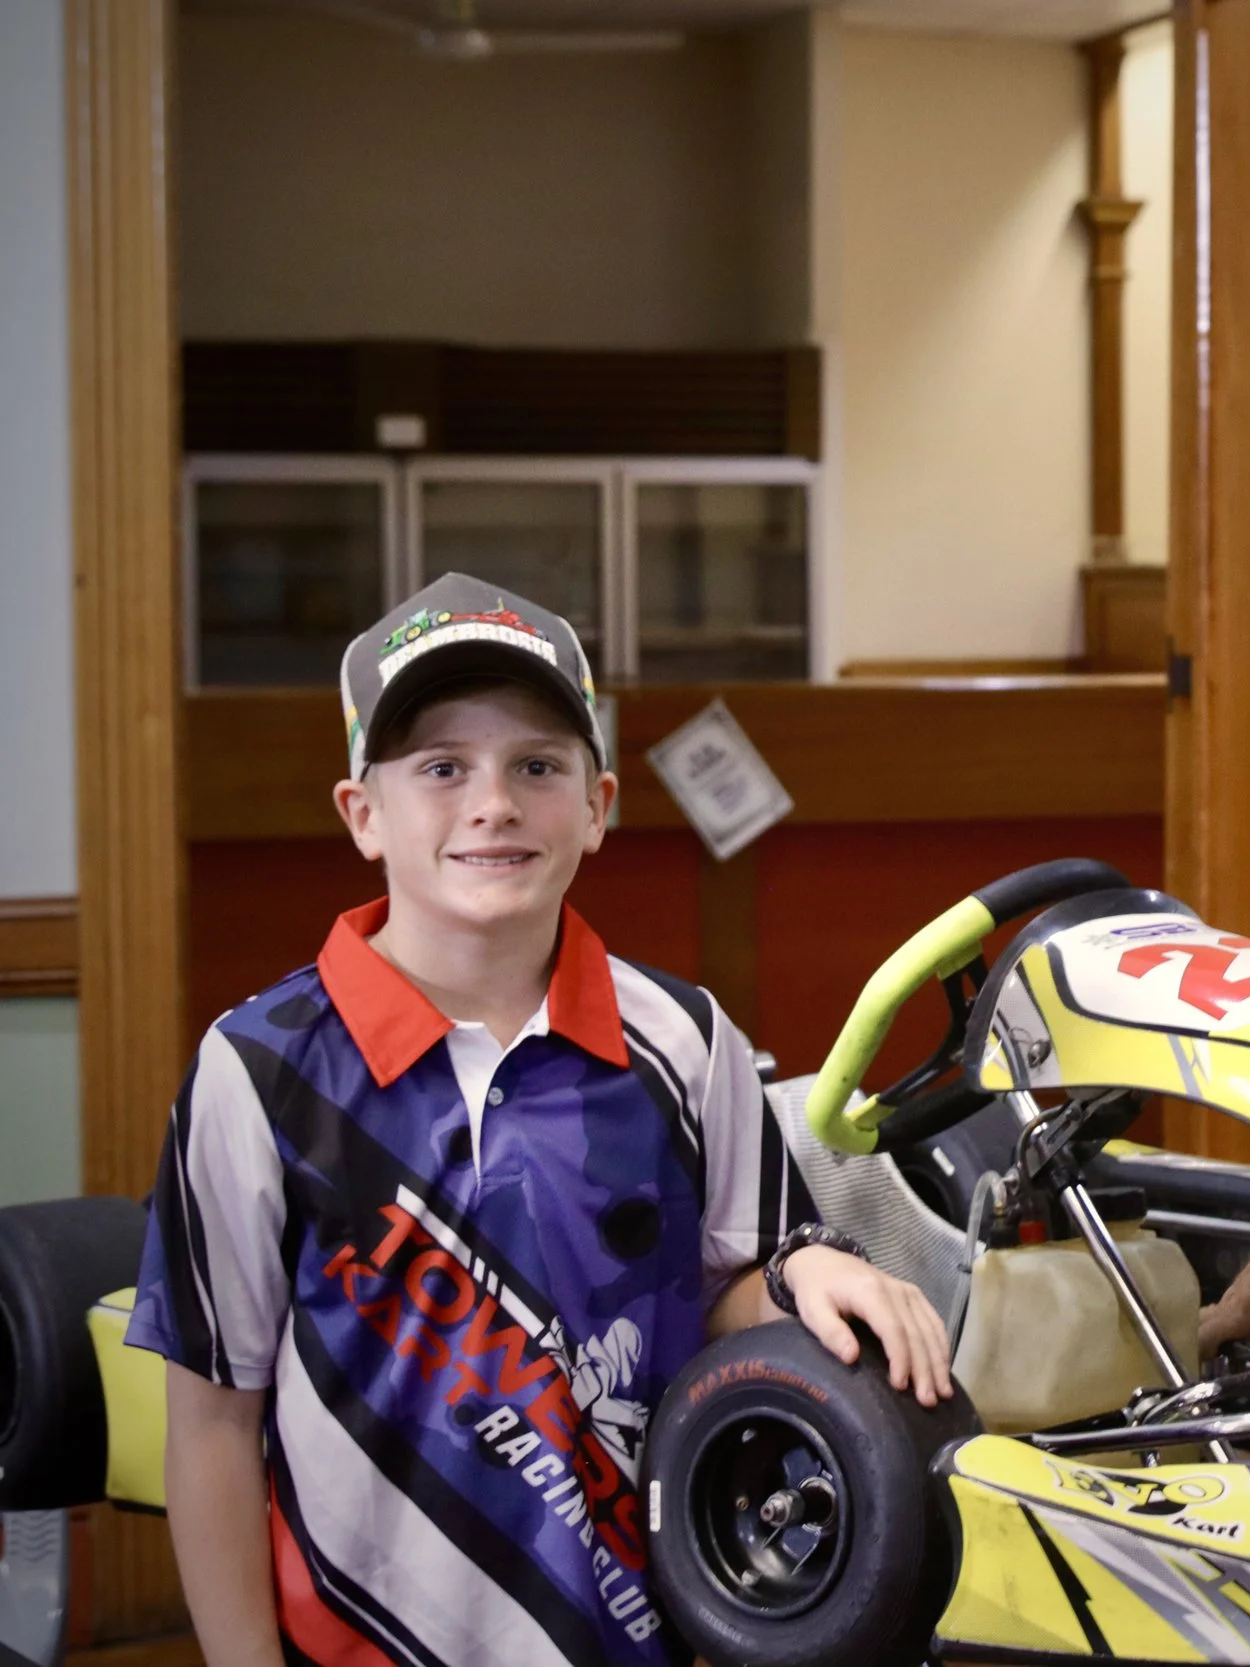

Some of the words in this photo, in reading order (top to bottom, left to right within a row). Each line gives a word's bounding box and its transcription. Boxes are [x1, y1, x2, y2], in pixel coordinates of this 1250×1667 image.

[322, 1244, 493, 1405] KART
[369, 1203, 646, 1572] TOWERS
[474, 1405, 595, 1549] RACING
[592, 1545, 662, 1643] CLUB
[1172, 1514, 1240, 1540] Kart
